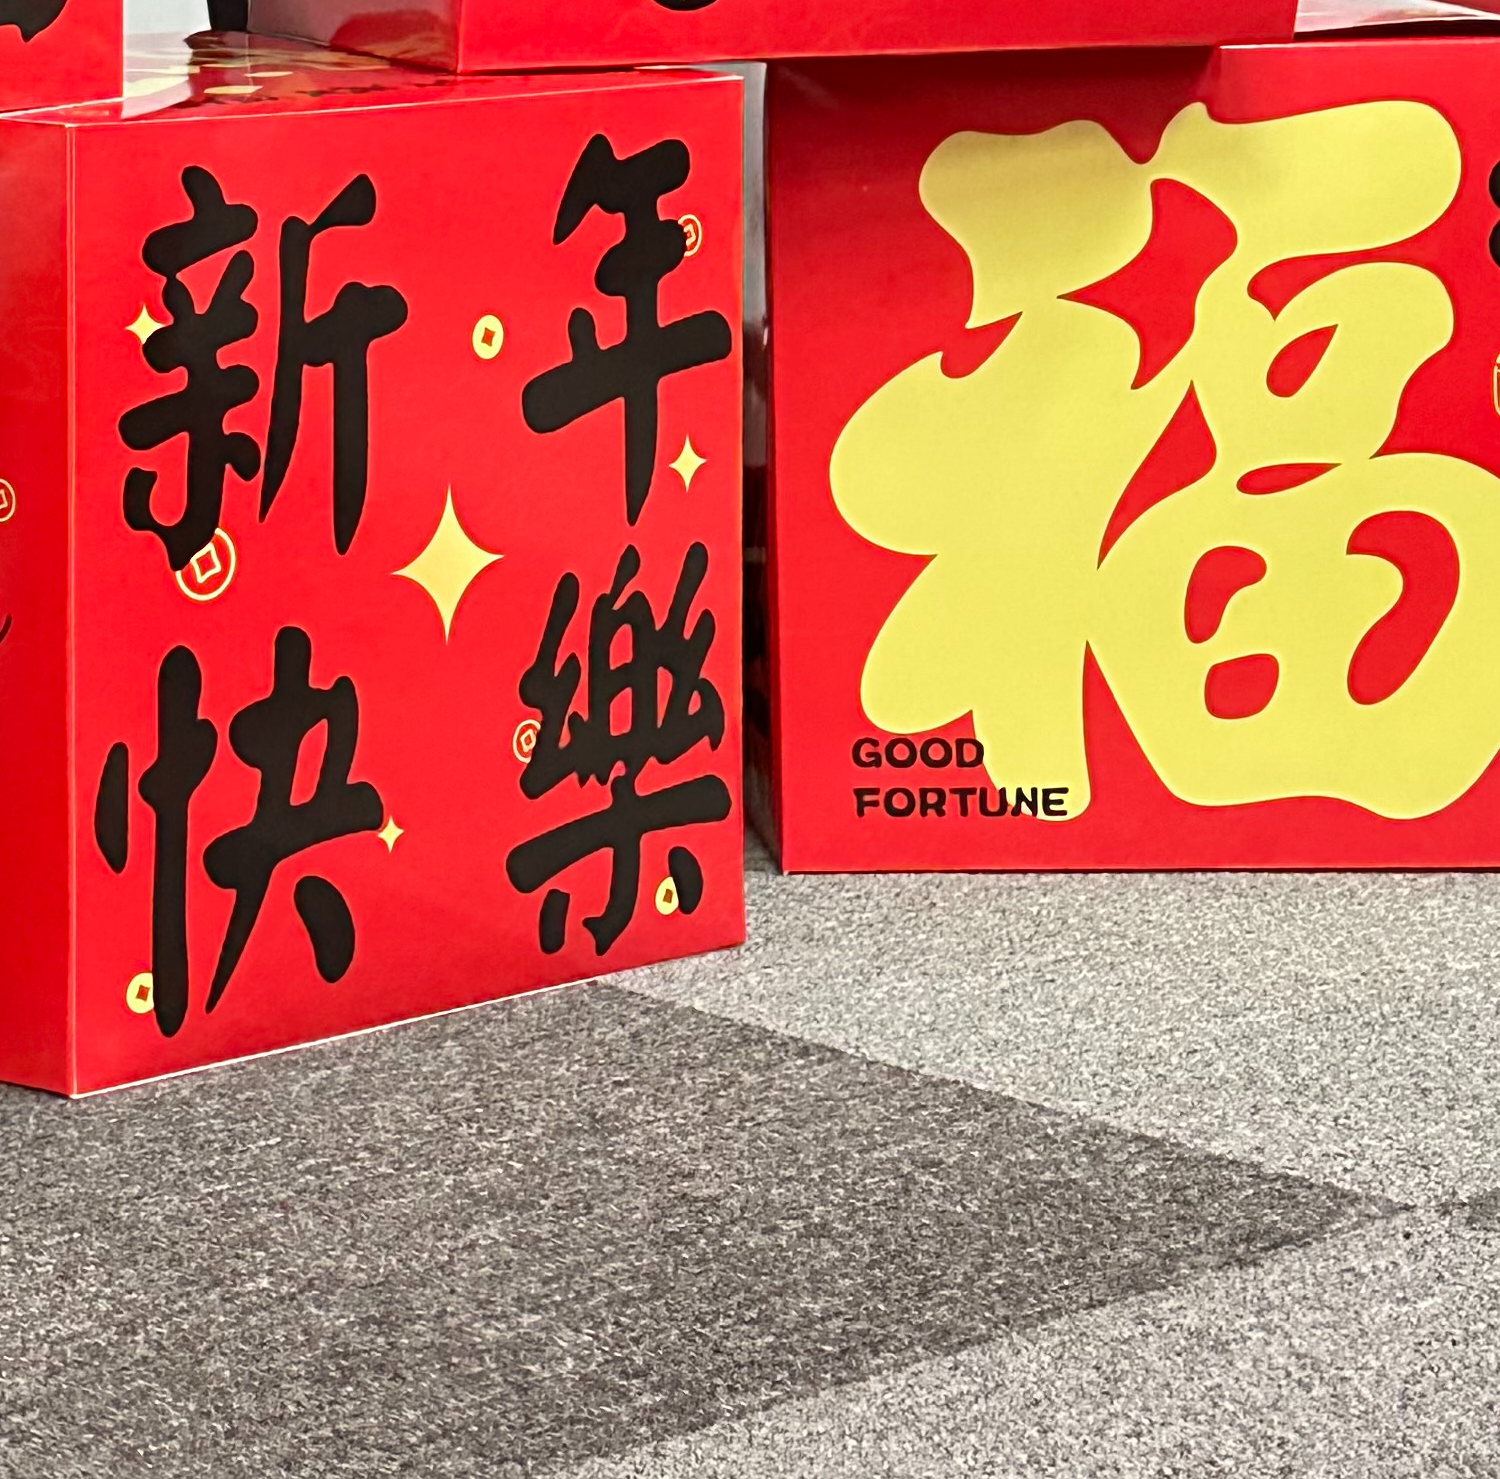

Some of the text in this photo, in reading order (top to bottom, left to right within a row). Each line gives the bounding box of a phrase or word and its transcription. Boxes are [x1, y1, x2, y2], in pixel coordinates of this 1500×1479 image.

[118, 133, 732, 572] 新年
[829, 100, 1500, 822] 福
[94, 542, 732, 1038] 快樂
[851, 737, 985, 769] GOOD
[854, 786, 1070, 818] FORTUNE
